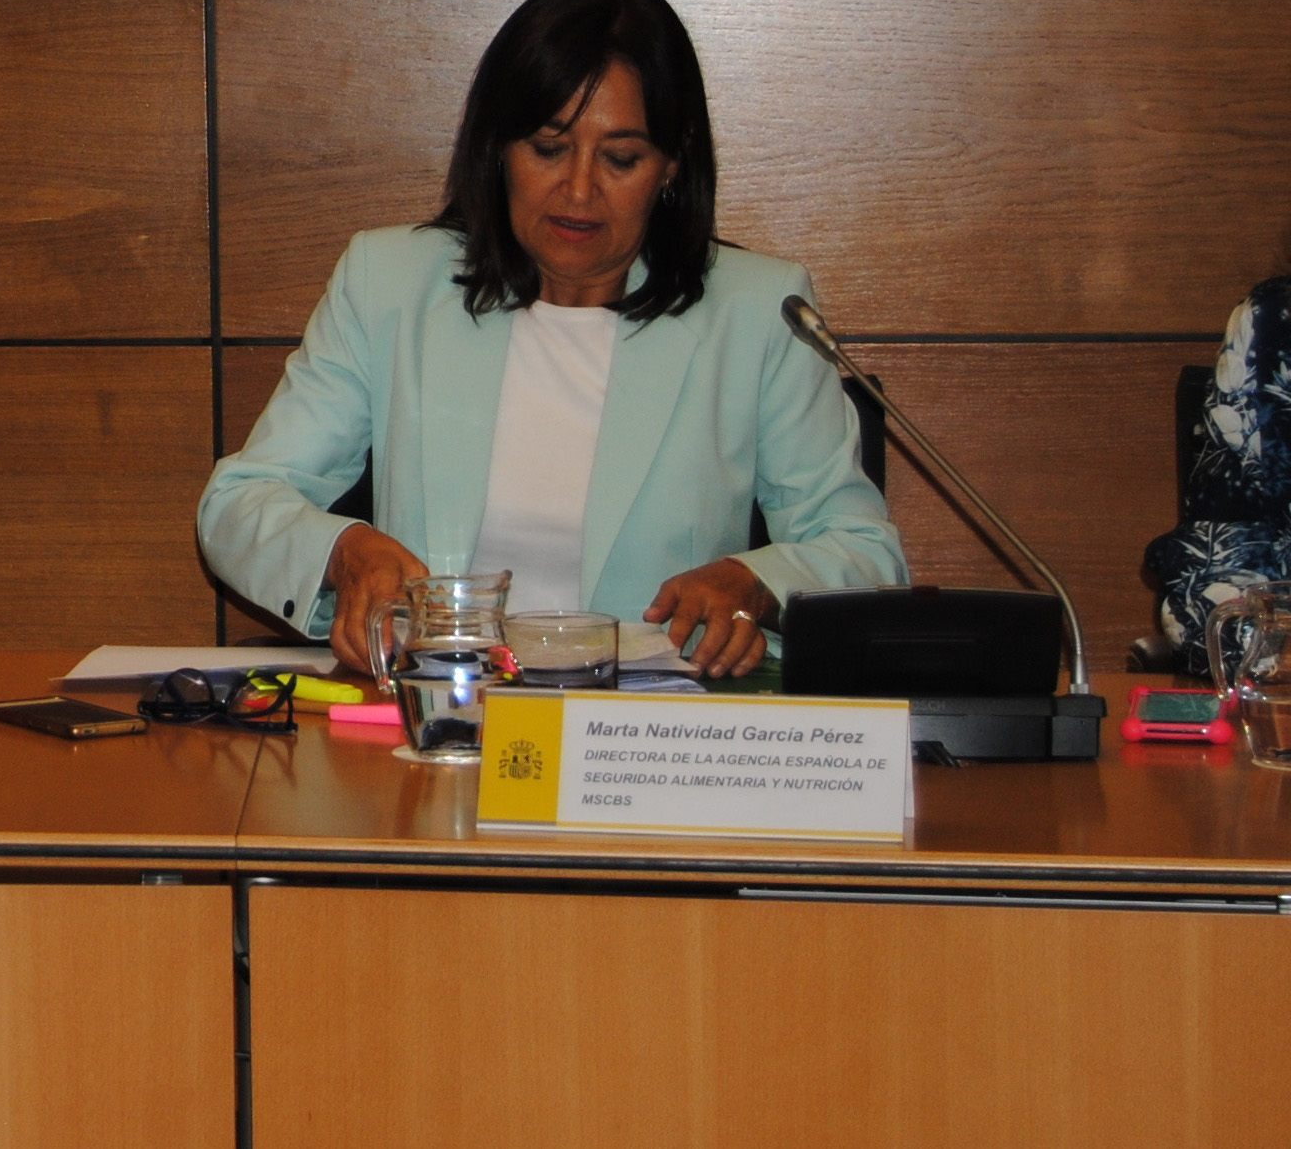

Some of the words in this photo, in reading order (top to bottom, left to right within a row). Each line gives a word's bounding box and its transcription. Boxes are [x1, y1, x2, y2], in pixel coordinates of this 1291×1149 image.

[586, 721, 639, 738] Marta
[645, 723, 737, 740] Natividad
[742, 726, 804, 742] García
[810, 728, 865, 744] Pérez
[584, 749, 667, 763] DIRECTORA
[671, 752, 691, 764] DE
[694, 753, 713, 764] LA
[716, 754, 781, 766] AGENCIA
[785, 755, 862, 768] ESPAÑOLA
[867, 758, 888, 770] DE
[583, 771, 668, 785] SEGURIDAD
[670, 774, 766, 788] ALIMENTARIA
[772, 778, 781, 788] Y
[783, 777, 863, 791] NUTRICIÓN
[581, 794, 633, 806] MSCBS
